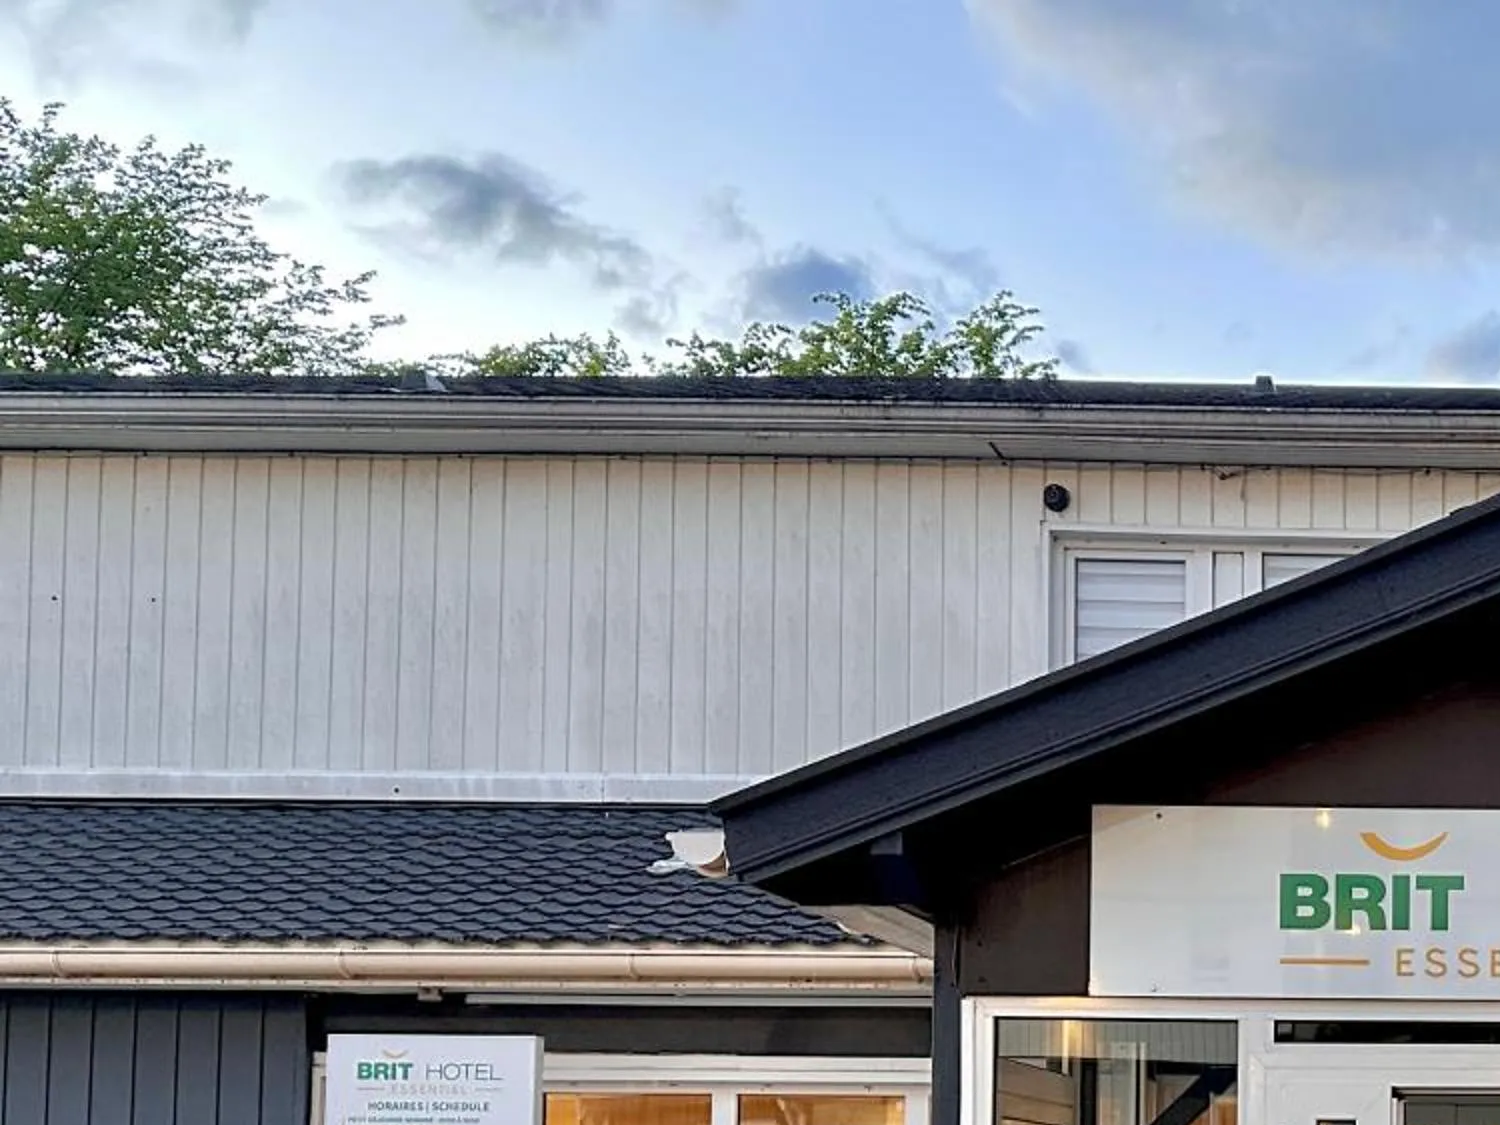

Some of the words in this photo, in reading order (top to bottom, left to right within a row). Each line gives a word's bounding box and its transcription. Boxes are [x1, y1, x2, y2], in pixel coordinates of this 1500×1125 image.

[1279, 873, 1465, 932] BRIT
[357, 1062, 414, 1081] BRIT
[425, 1063, 503, 1081] HOTEL
[367, 1101, 424, 1112] HORAIRES
[431, 1101, 490, 1112] SCHEDULE
